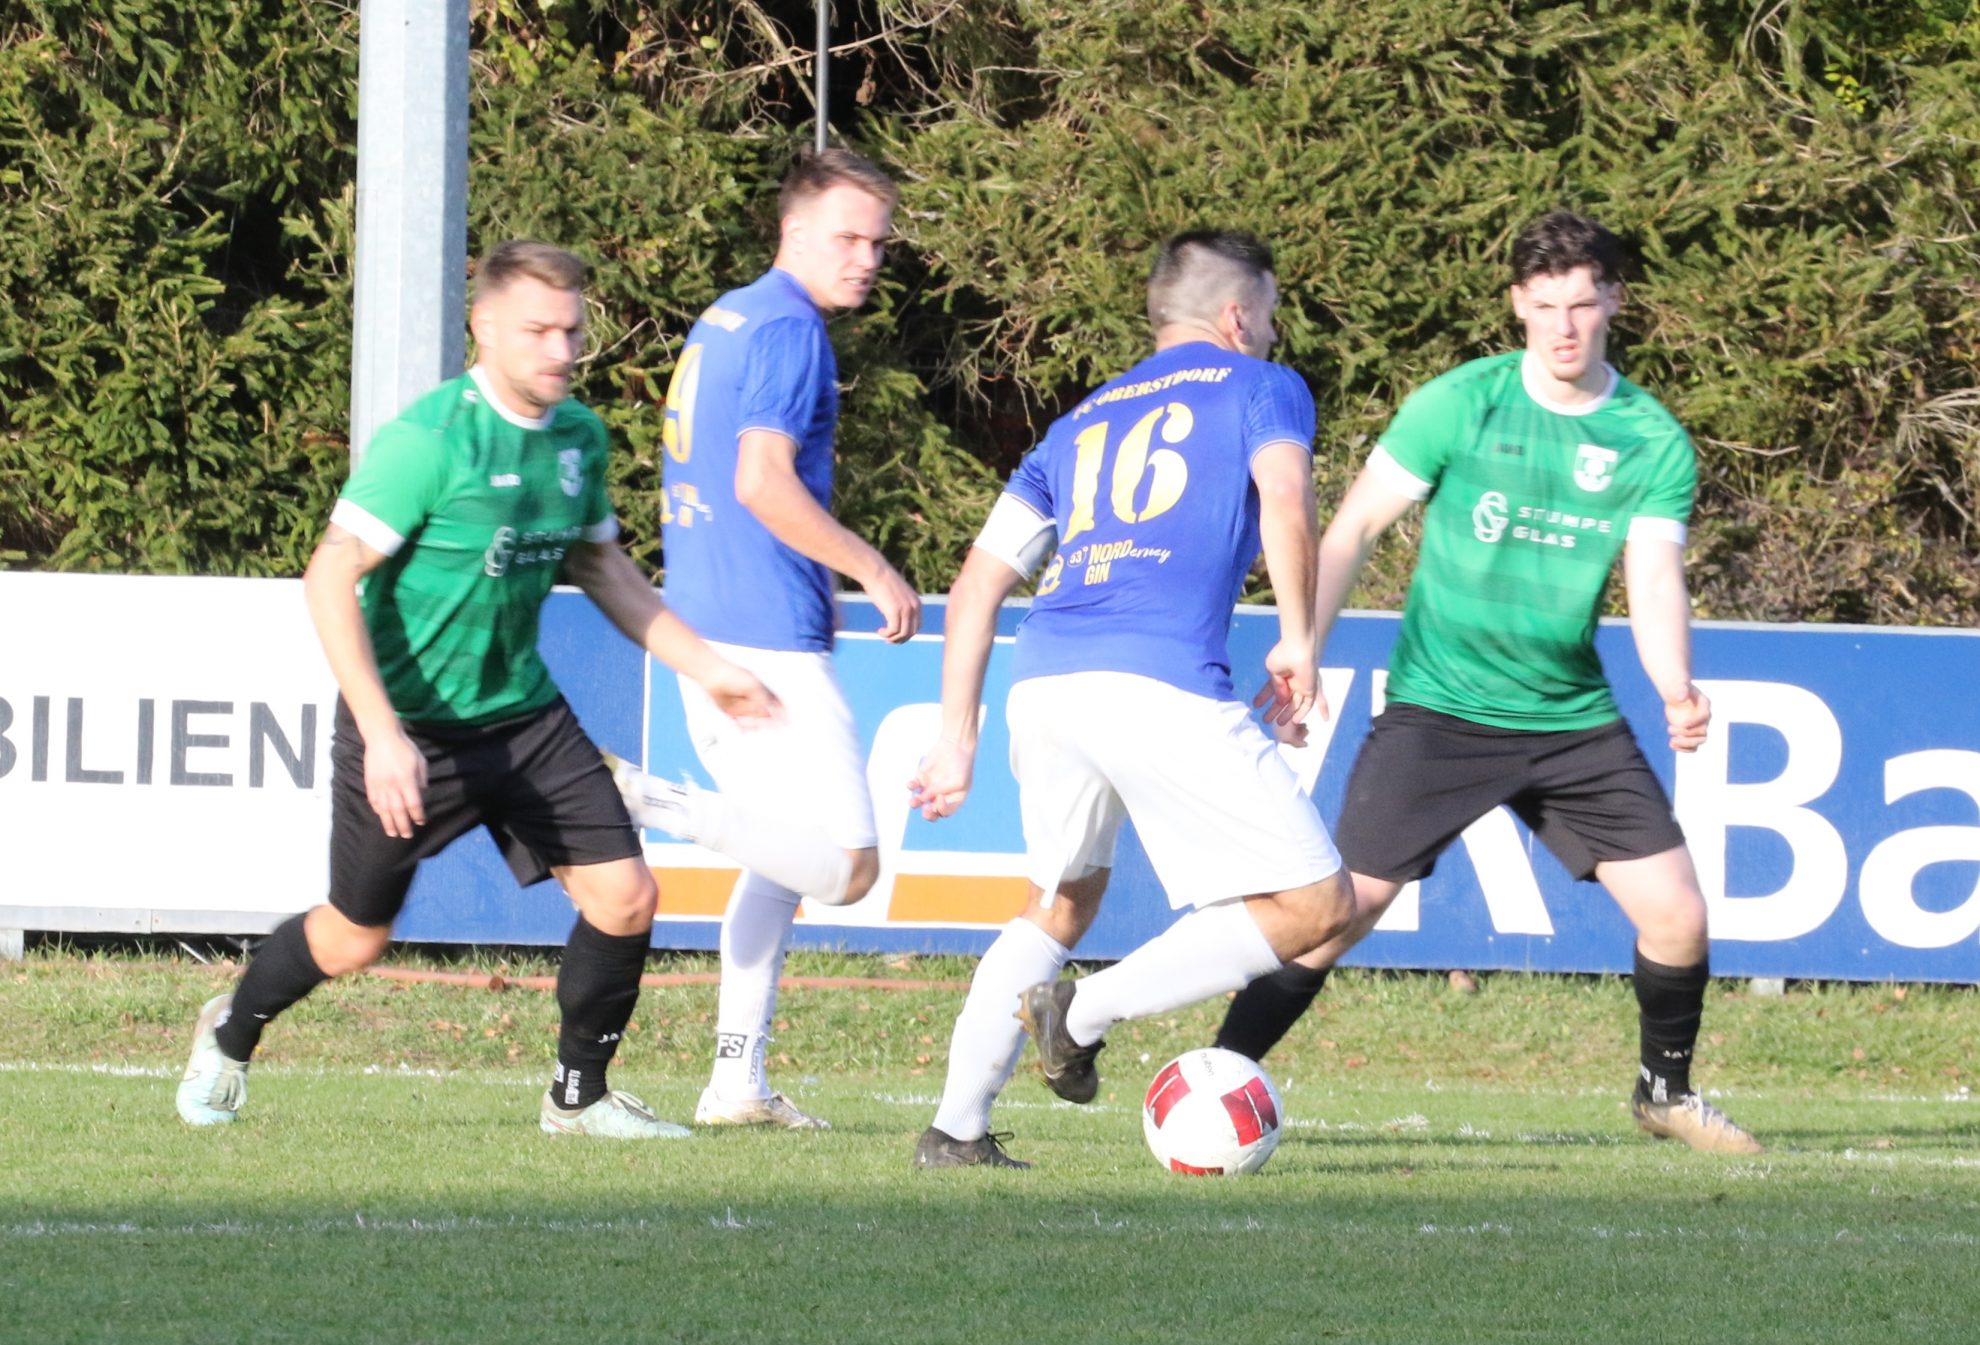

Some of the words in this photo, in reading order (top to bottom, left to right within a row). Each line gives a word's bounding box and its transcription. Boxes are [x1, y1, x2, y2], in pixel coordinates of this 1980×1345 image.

[1095, 367, 1232, 406] OBERSTDORF
[1063, 402, 1194, 544] 16
[1517, 506, 1613, 533] STUMPE
[1512, 526, 1577, 549] GLAS
[1084, 562, 1111, 586] GIN
[0, 695, 317, 789] ILIEN
[717, 1033, 745, 1058] FS
